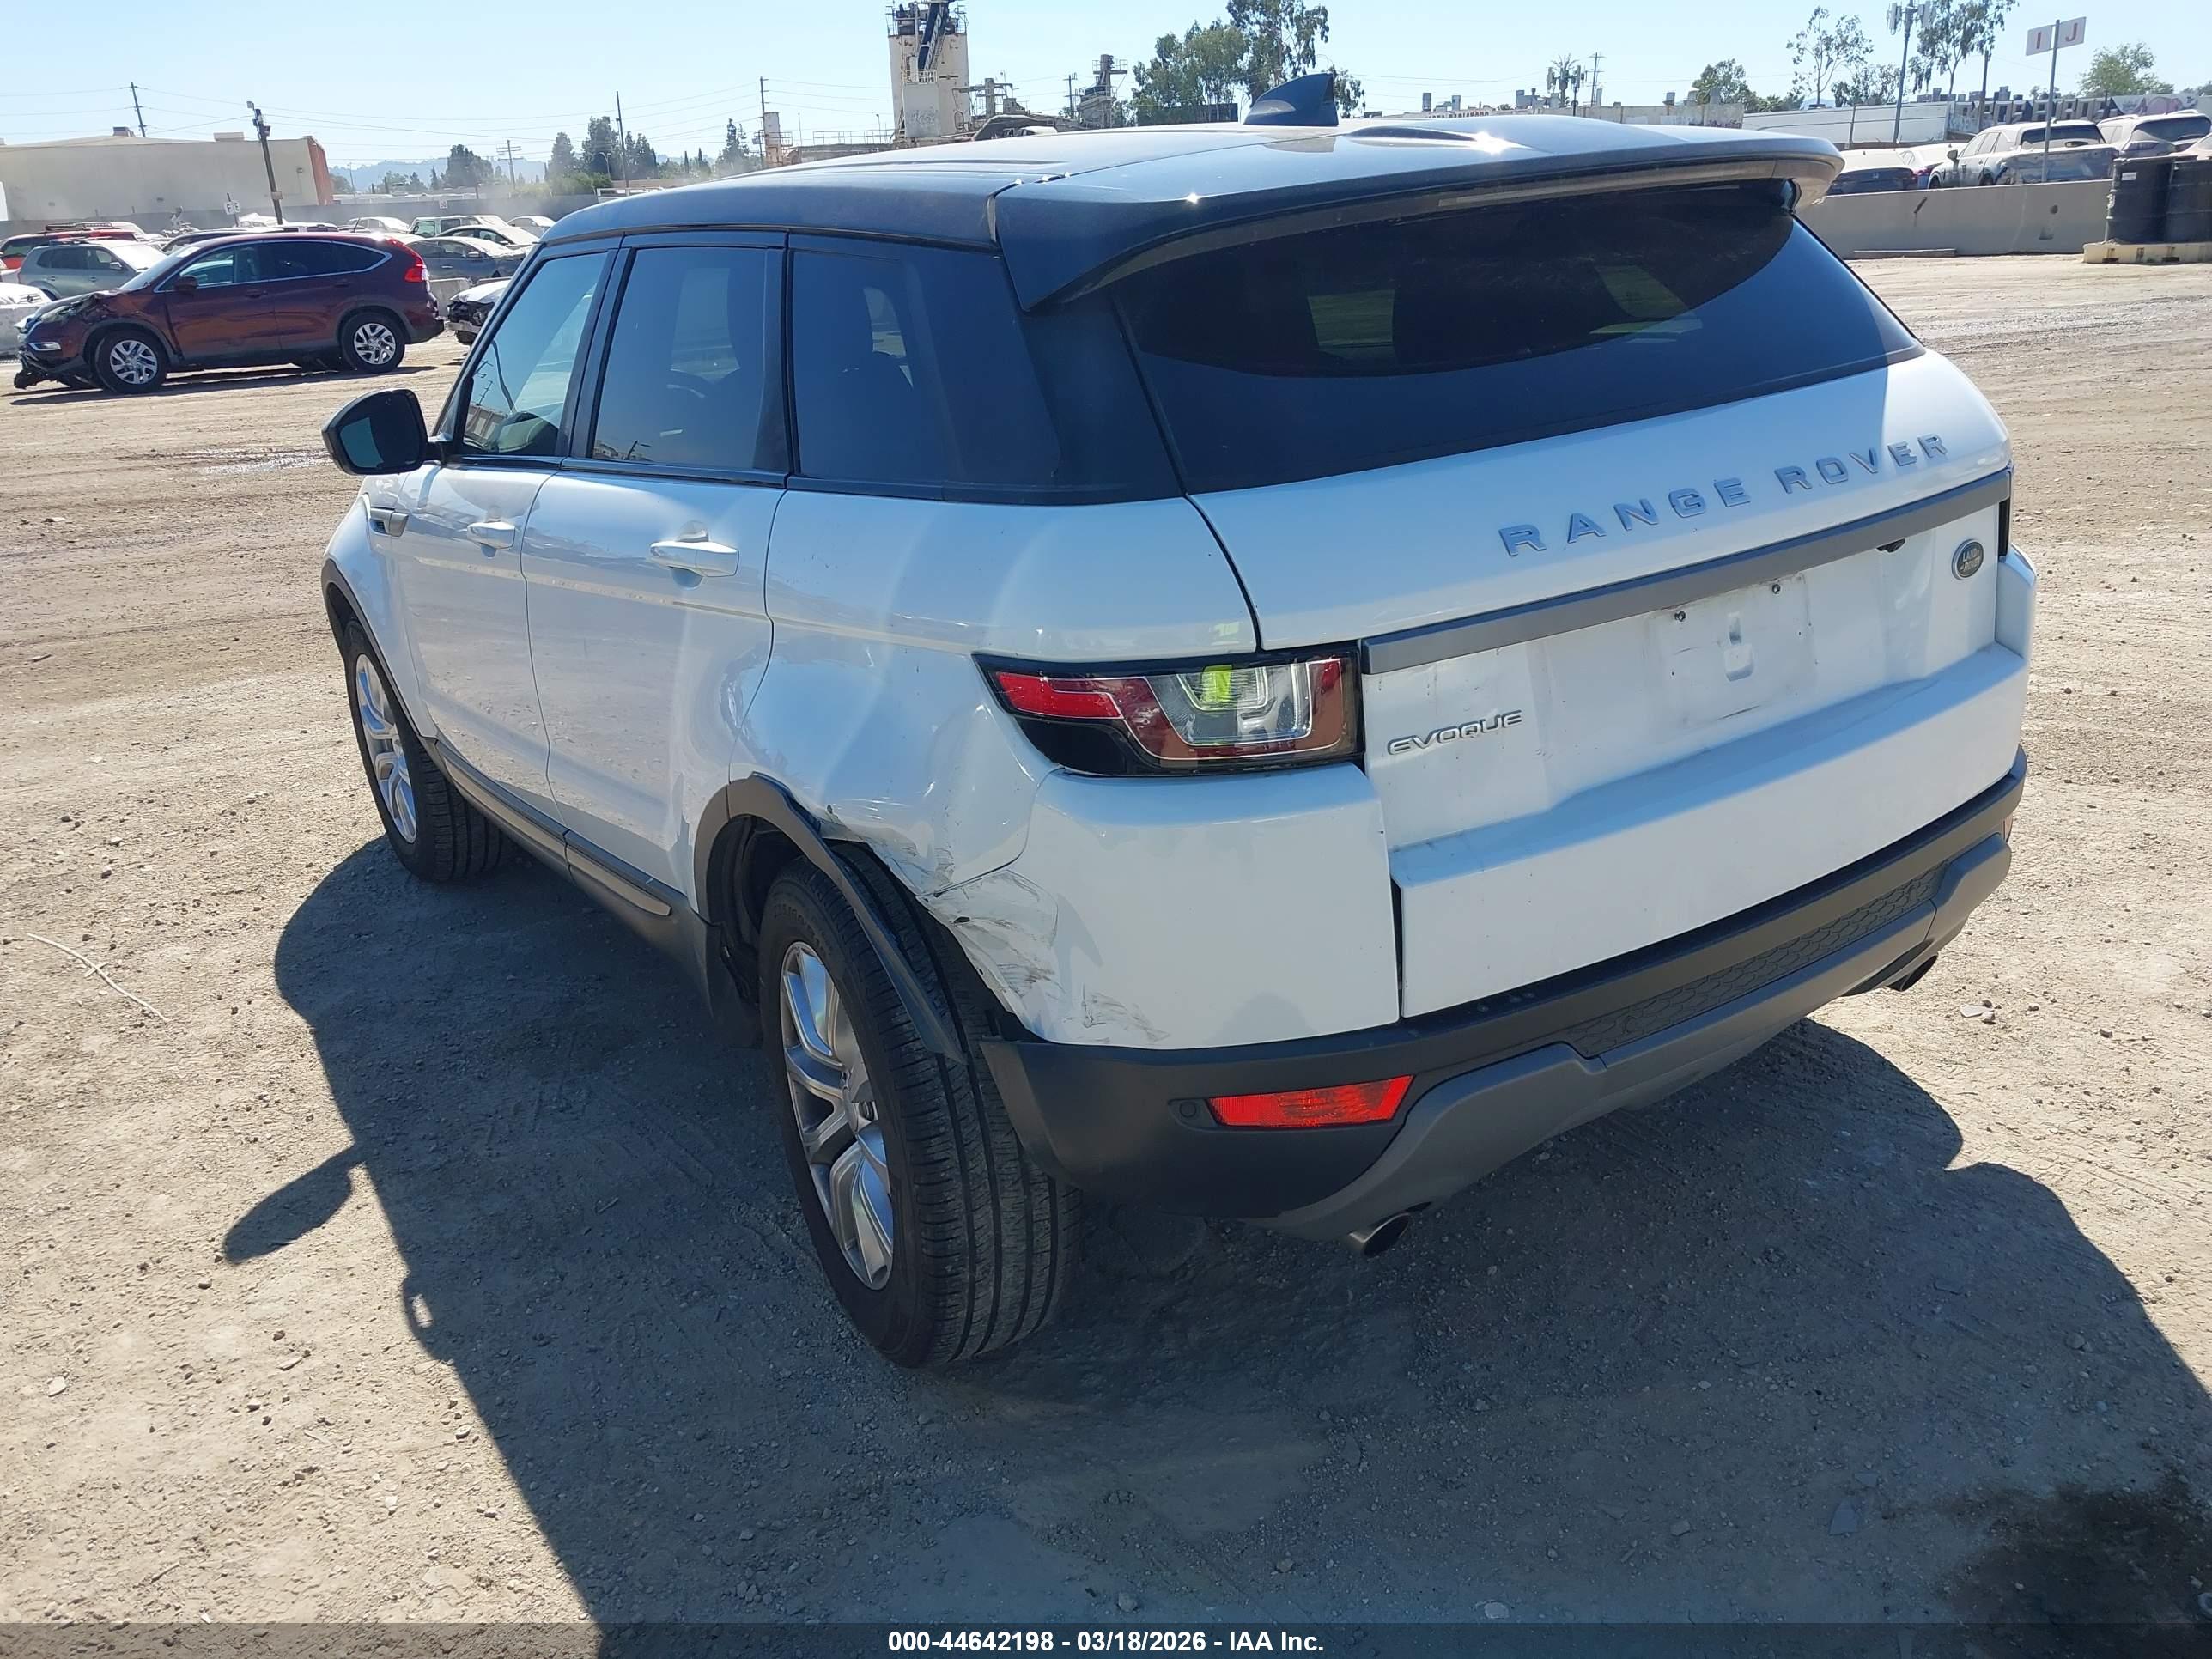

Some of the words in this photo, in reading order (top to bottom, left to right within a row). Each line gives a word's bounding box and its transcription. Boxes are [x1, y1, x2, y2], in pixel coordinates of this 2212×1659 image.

[2065, 23, 2078, 42] J
[1498, 477, 1751, 556] RANGE
[1774, 433, 1948, 494] ROVER
[1387, 709, 1522, 756] EVOQUE
